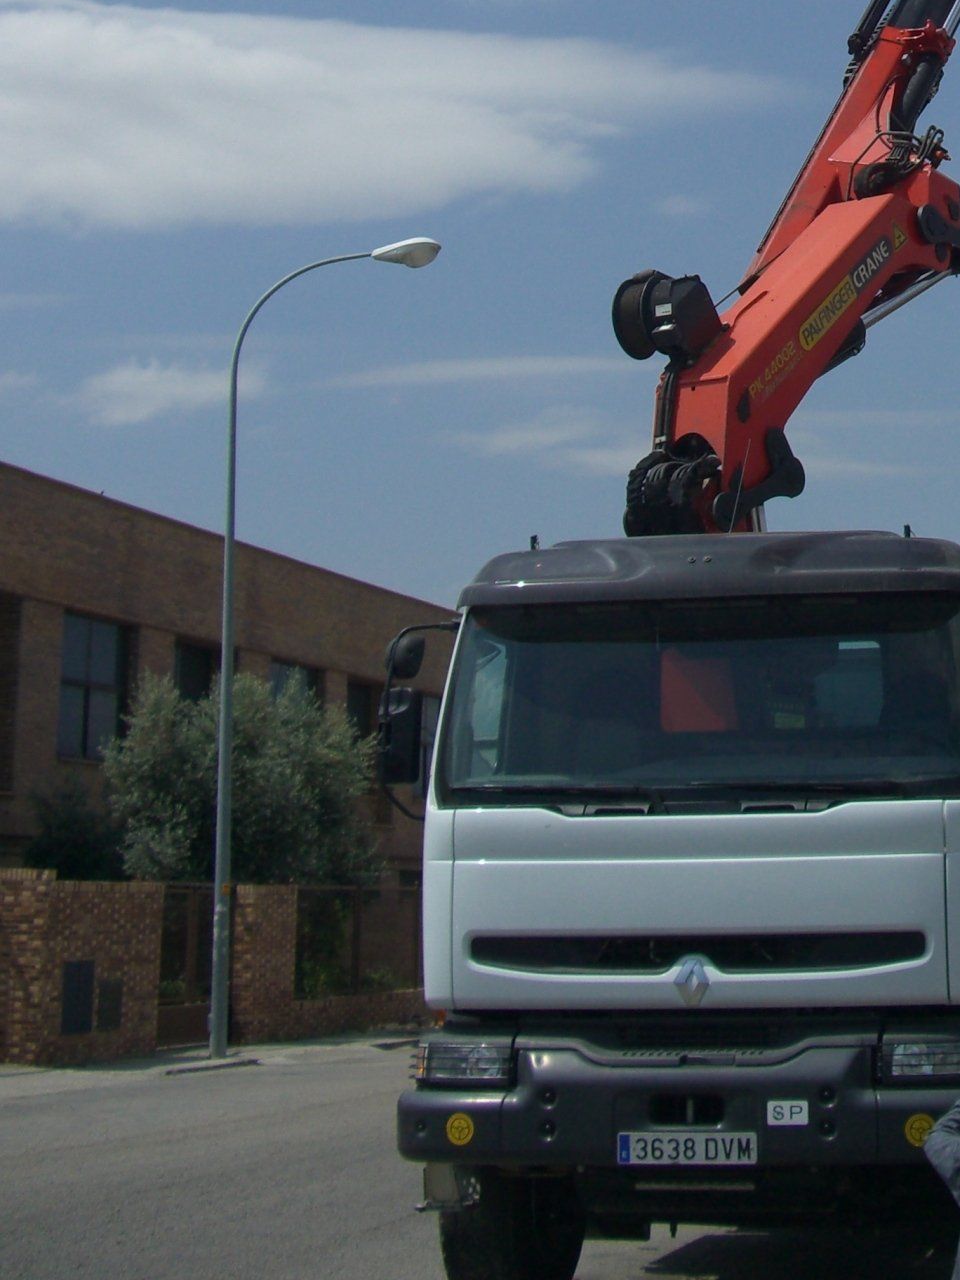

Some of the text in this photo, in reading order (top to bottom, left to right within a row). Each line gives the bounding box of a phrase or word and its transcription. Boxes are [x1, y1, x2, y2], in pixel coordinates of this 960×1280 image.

[801, 240, 889, 345] PALFINGER CRANE
[772, 1105, 803, 1120] SP
[635, 1138, 696, 1160] 3638
[705, 1138, 751, 1160] DVM
